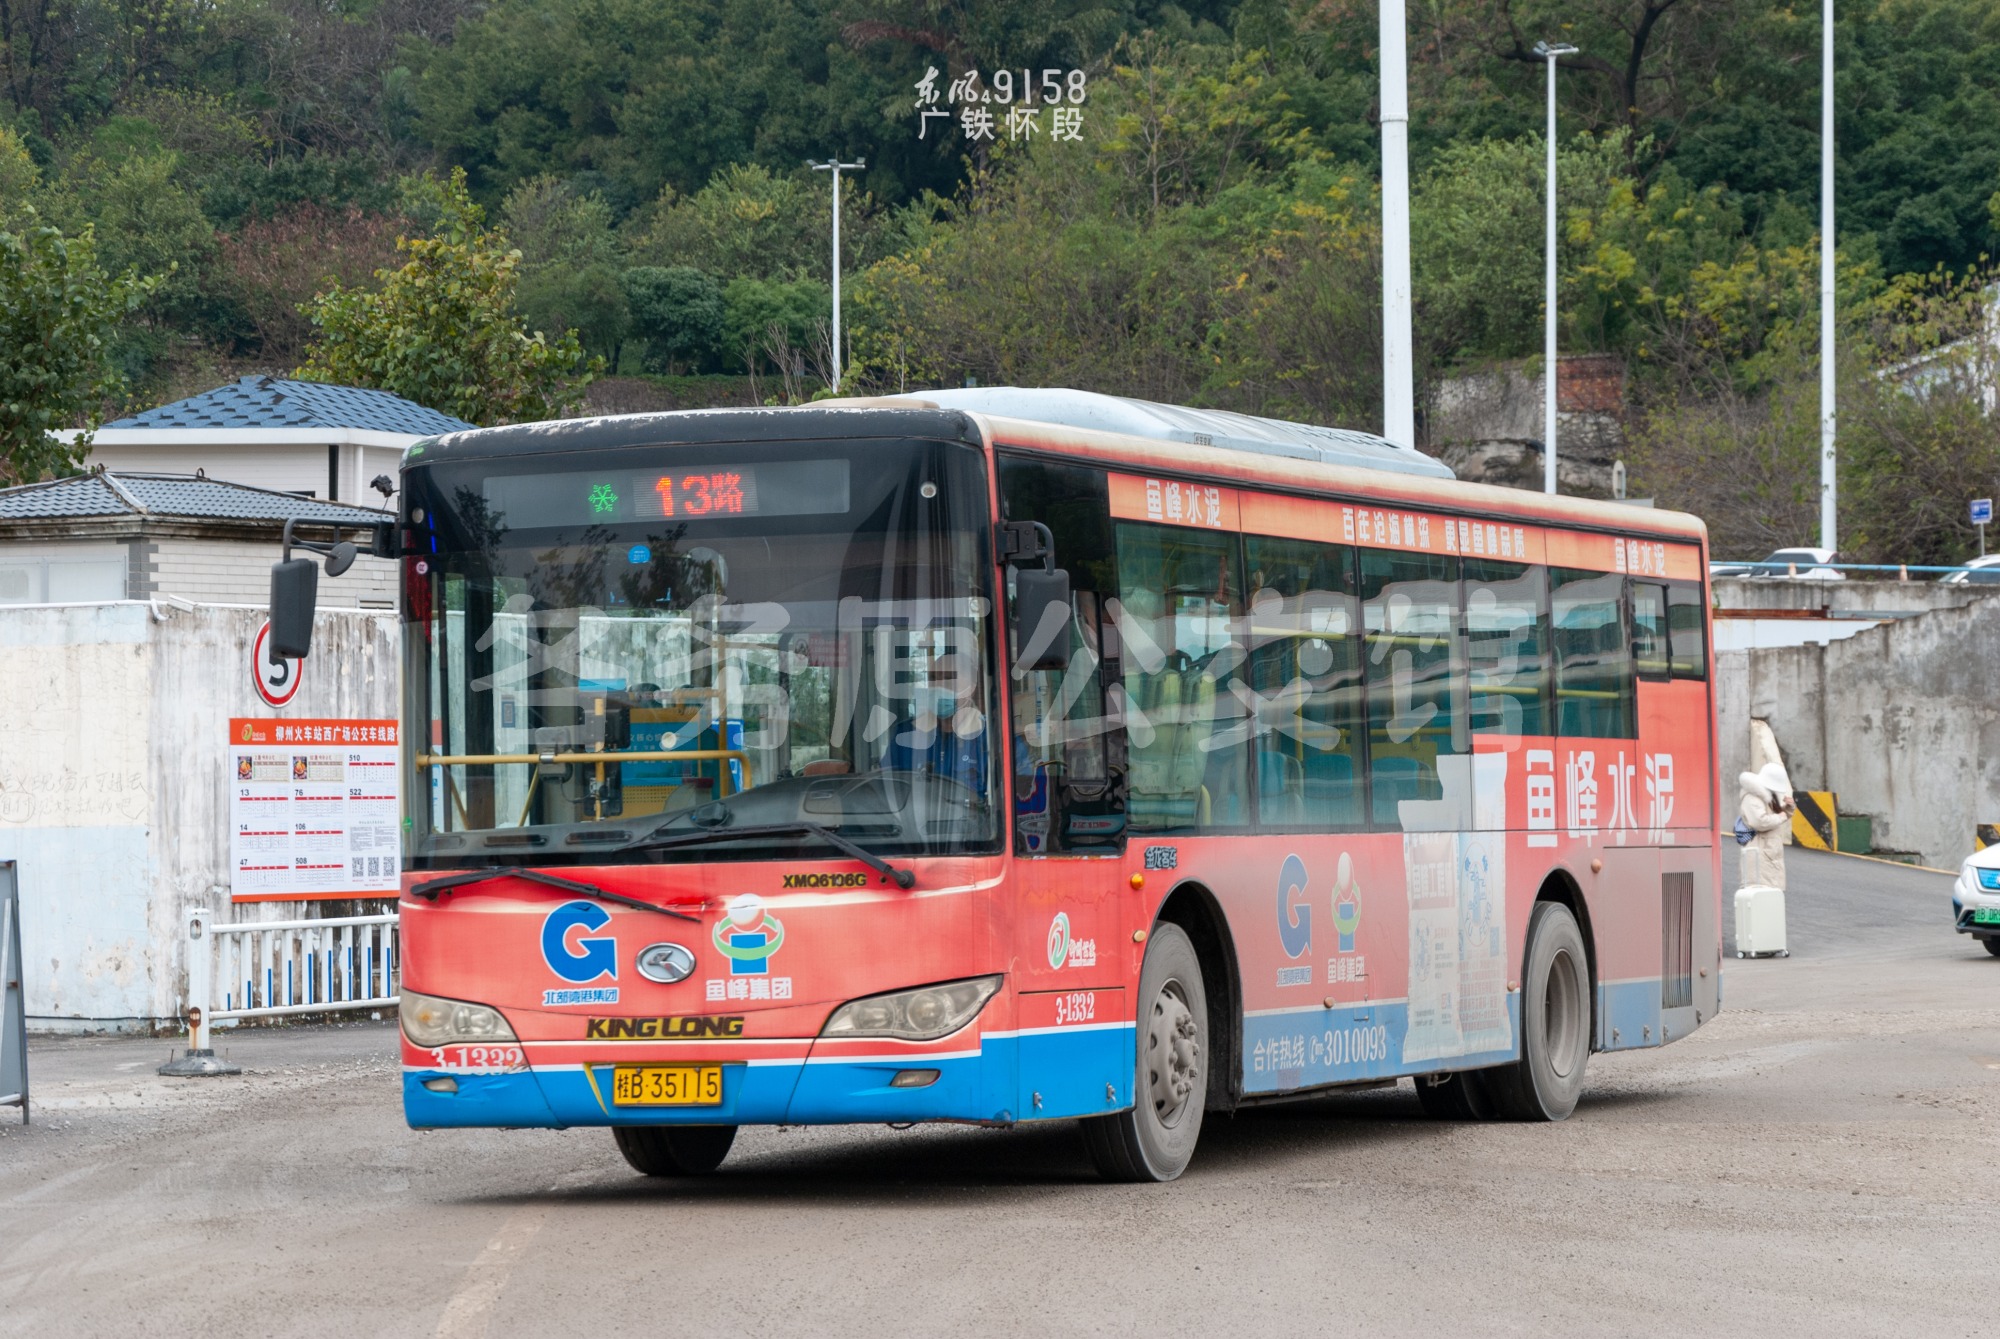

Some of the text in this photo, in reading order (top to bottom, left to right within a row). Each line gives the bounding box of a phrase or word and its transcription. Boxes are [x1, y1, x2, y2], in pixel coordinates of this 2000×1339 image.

[656, 473, 744, 516] 13路
[1146, 480, 1221, 527] 鱼峰水泥
[1615, 538, 1665, 576] 鱼峰水泥
[276, 725, 398, 742] 柳州火车站西广场公交车线路
[349, 788, 362, 796] 522
[1526, 749, 1675, 847] 鱼峰水泥
[240, 823, 248, 831] 14
[240, 858, 248, 866] 47
[295, 857, 308, 865] 508
[1144, 846, 1177, 869] 金龙客车
[783, 873, 867, 888] XMQ6106G
[1328, 956, 1364, 983] 鱼峰集团
[706, 977, 792, 1001] 鱼峰集团
[1056, 992, 1095, 1025] 3-1332
[587, 1016, 744, 1039] KING LONG
[1253, 1025, 1386, 1072] 合作热线 3010093
